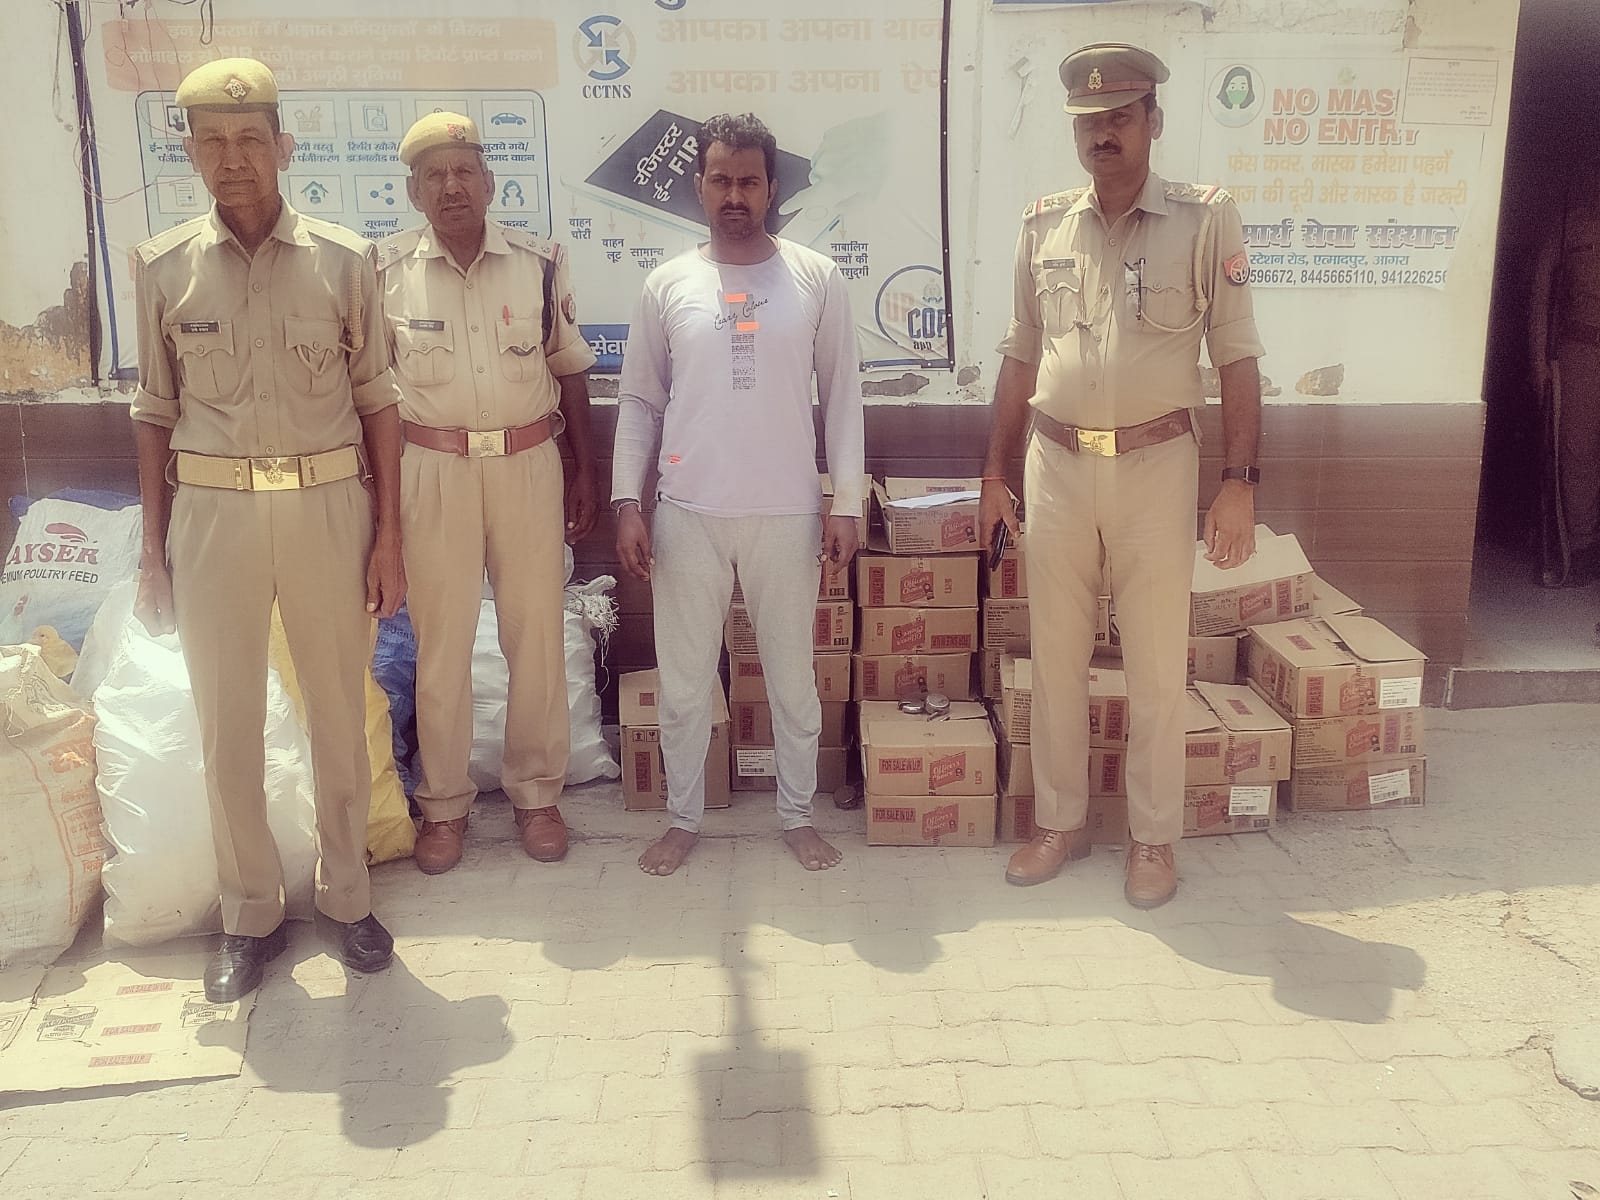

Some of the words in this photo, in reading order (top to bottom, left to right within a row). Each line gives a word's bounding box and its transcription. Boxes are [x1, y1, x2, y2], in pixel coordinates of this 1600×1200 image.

[883, 18, 943, 41] थान
[582, 84, 632, 99] CCTNS
[1272, 88, 1320, 115] NO
[1328, 88, 1400, 116] MAS
[1263, 118, 1310, 145] NO
[668, 136, 698, 176] FIR
[568, 218, 592, 228] वाहन
[571, 228, 592, 239] चोरी
[601, 238, 624, 248] वाहन
[855, 253, 868, 264] की
[1249, 270, 1296, 285] 596672,
[1300, 270, 1377, 285] 8445665110,
[23, 568, 68, 581] POULTRY
[68, 570, 99, 584] FEED
